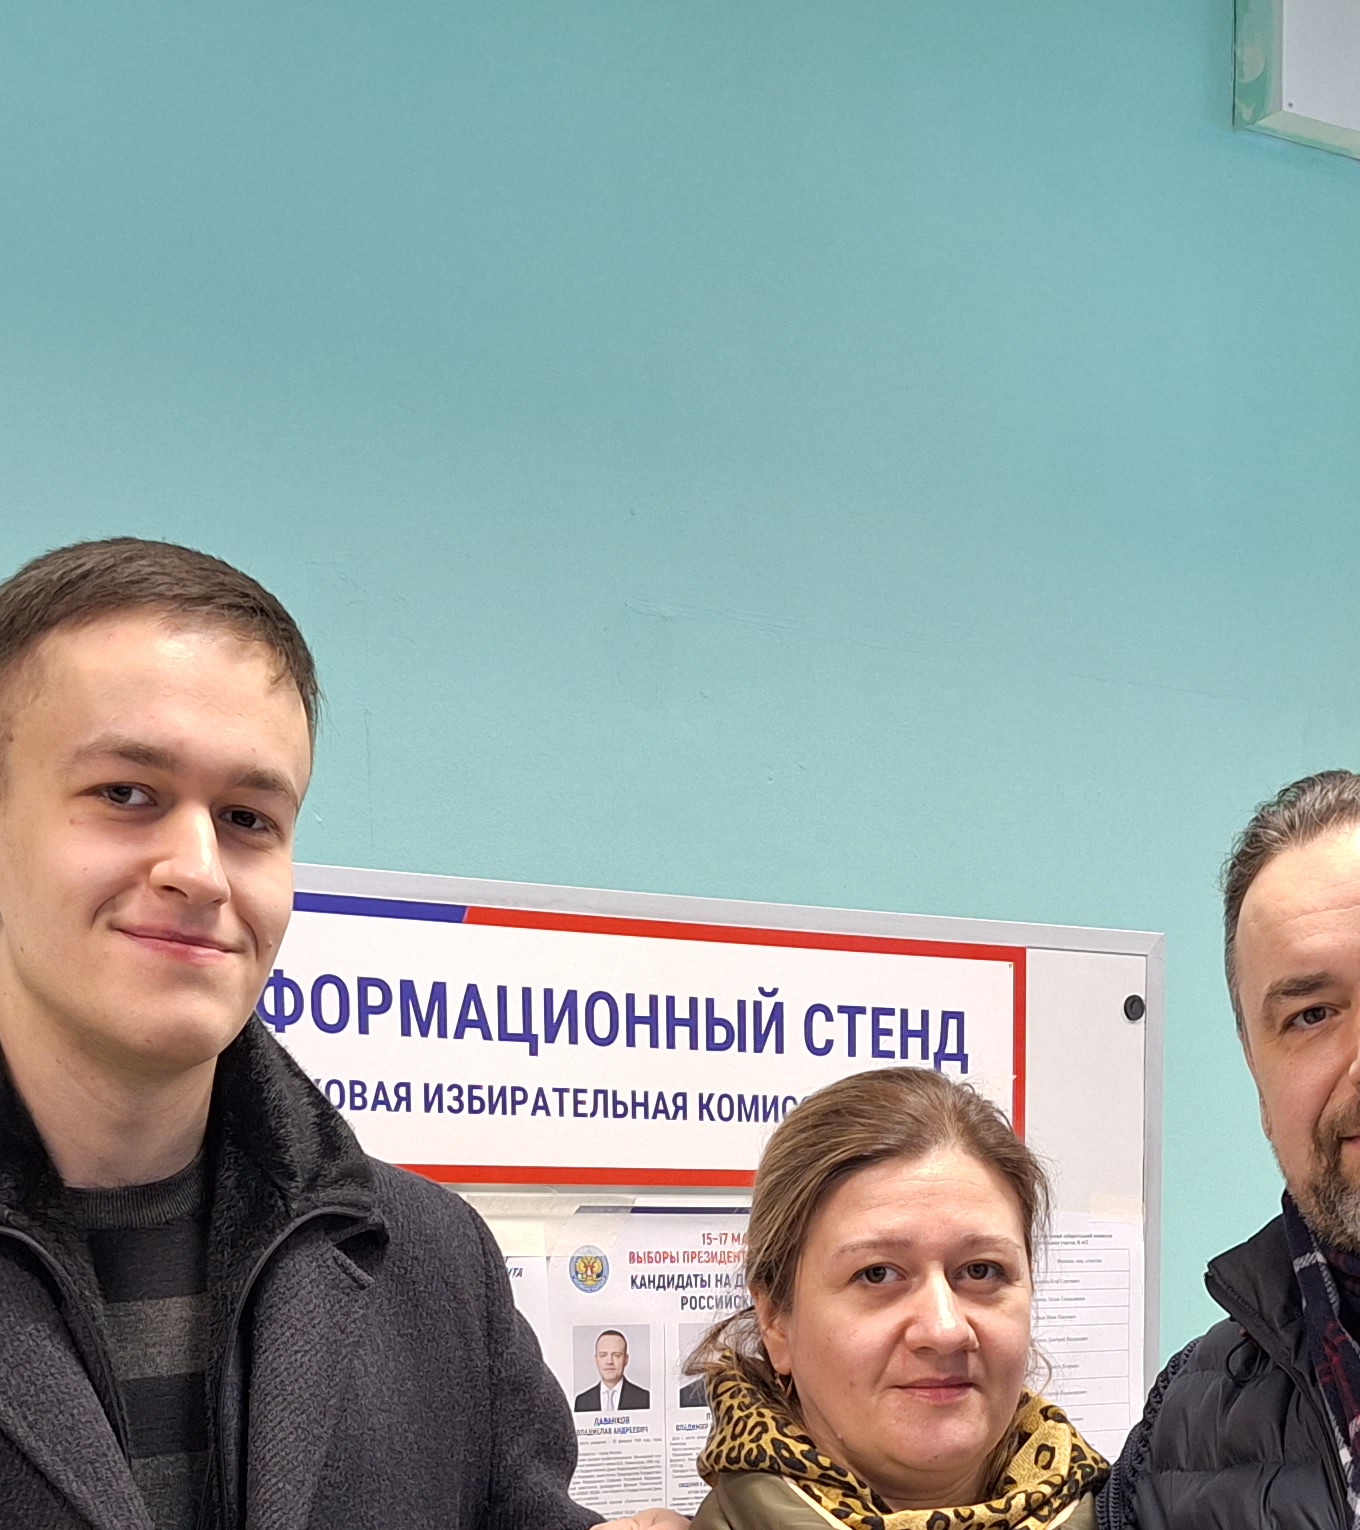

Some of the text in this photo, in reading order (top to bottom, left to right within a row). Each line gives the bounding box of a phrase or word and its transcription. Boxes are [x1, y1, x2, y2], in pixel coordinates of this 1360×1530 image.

[256, 969, 970, 1073] ФОРМАЦИОННЫЙ СТЕНД
[313, 1078, 812, 1123] ОВАЯ ИЗБИРАТЕЛЬНАЯ КОМИС
[629, 1251, 679, 1264] ВЫБОРЫ
[630, 1273, 711, 1291] КАНДИДАТЫ
[715, 1274, 731, 1288] НА
[680, 1291, 752, 1310] РОССИЙСК
